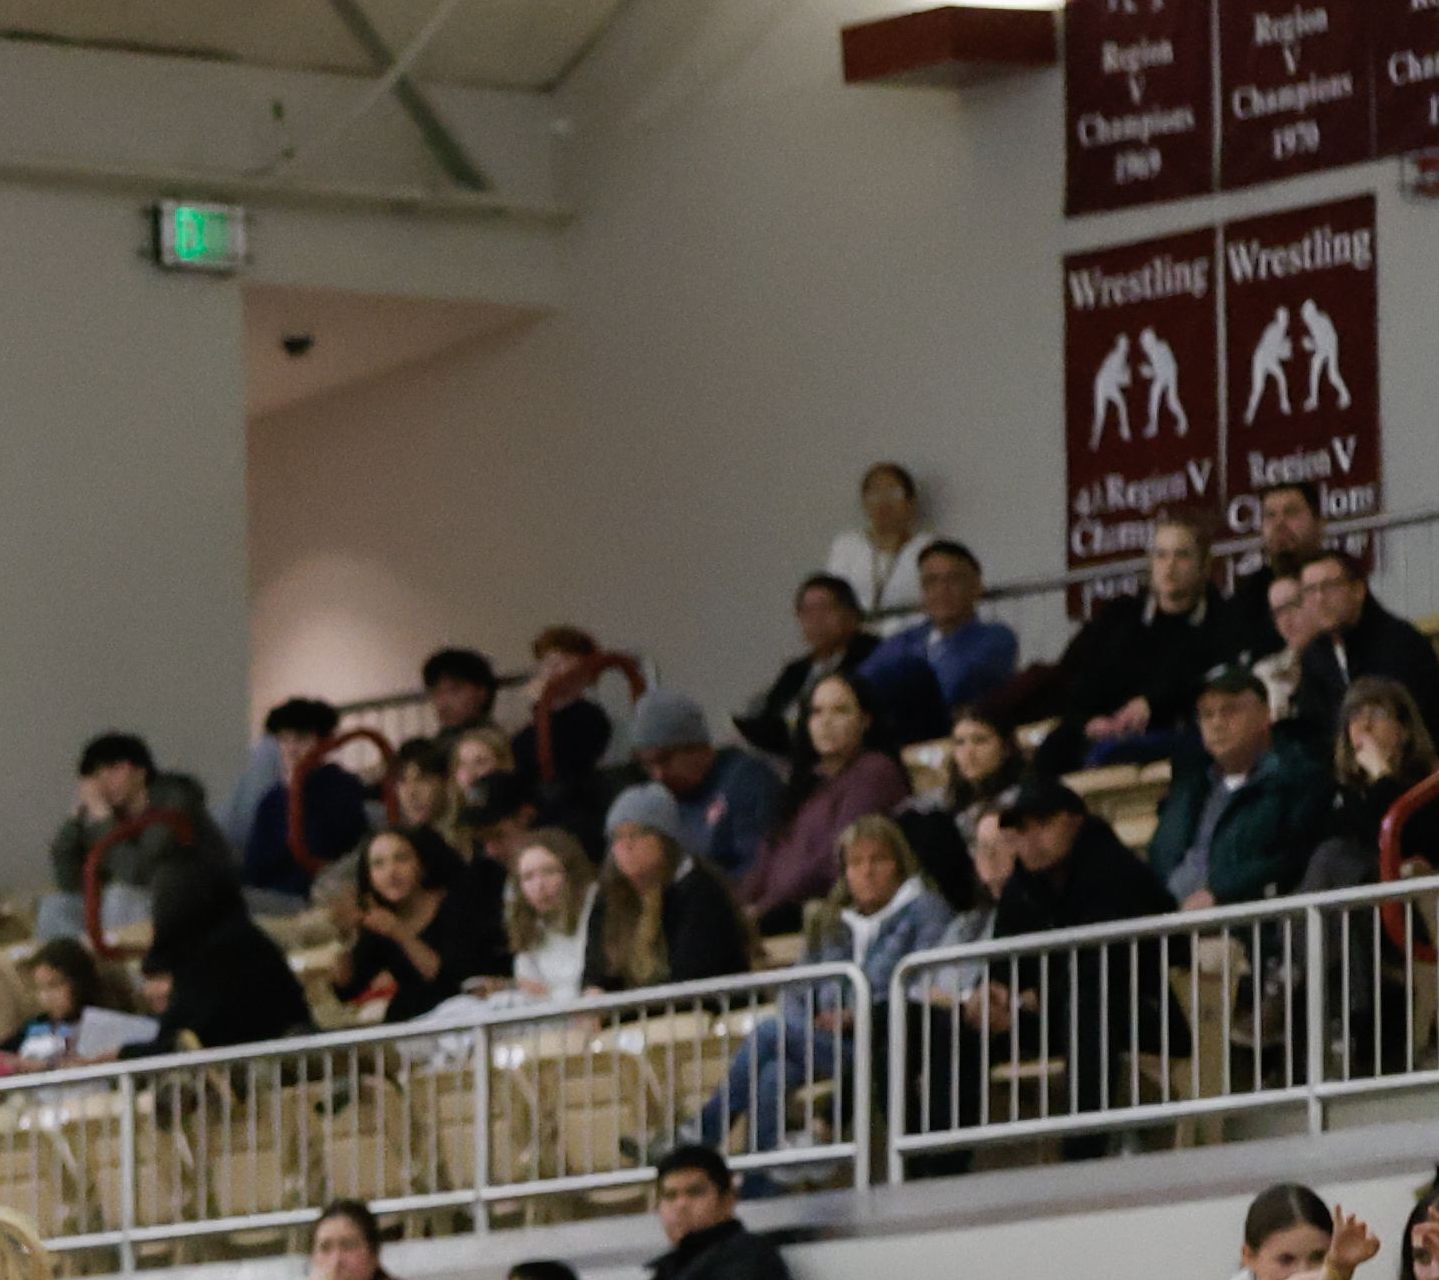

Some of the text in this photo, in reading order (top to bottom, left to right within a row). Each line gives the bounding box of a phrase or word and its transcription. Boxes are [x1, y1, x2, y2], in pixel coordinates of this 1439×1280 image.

[1226, 224, 1373, 285] Wrestling
[1068, 255, 1209, 309] Wrestling
[1186, 459, 1212, 495] V
[1330, 434, 1356, 474] V
